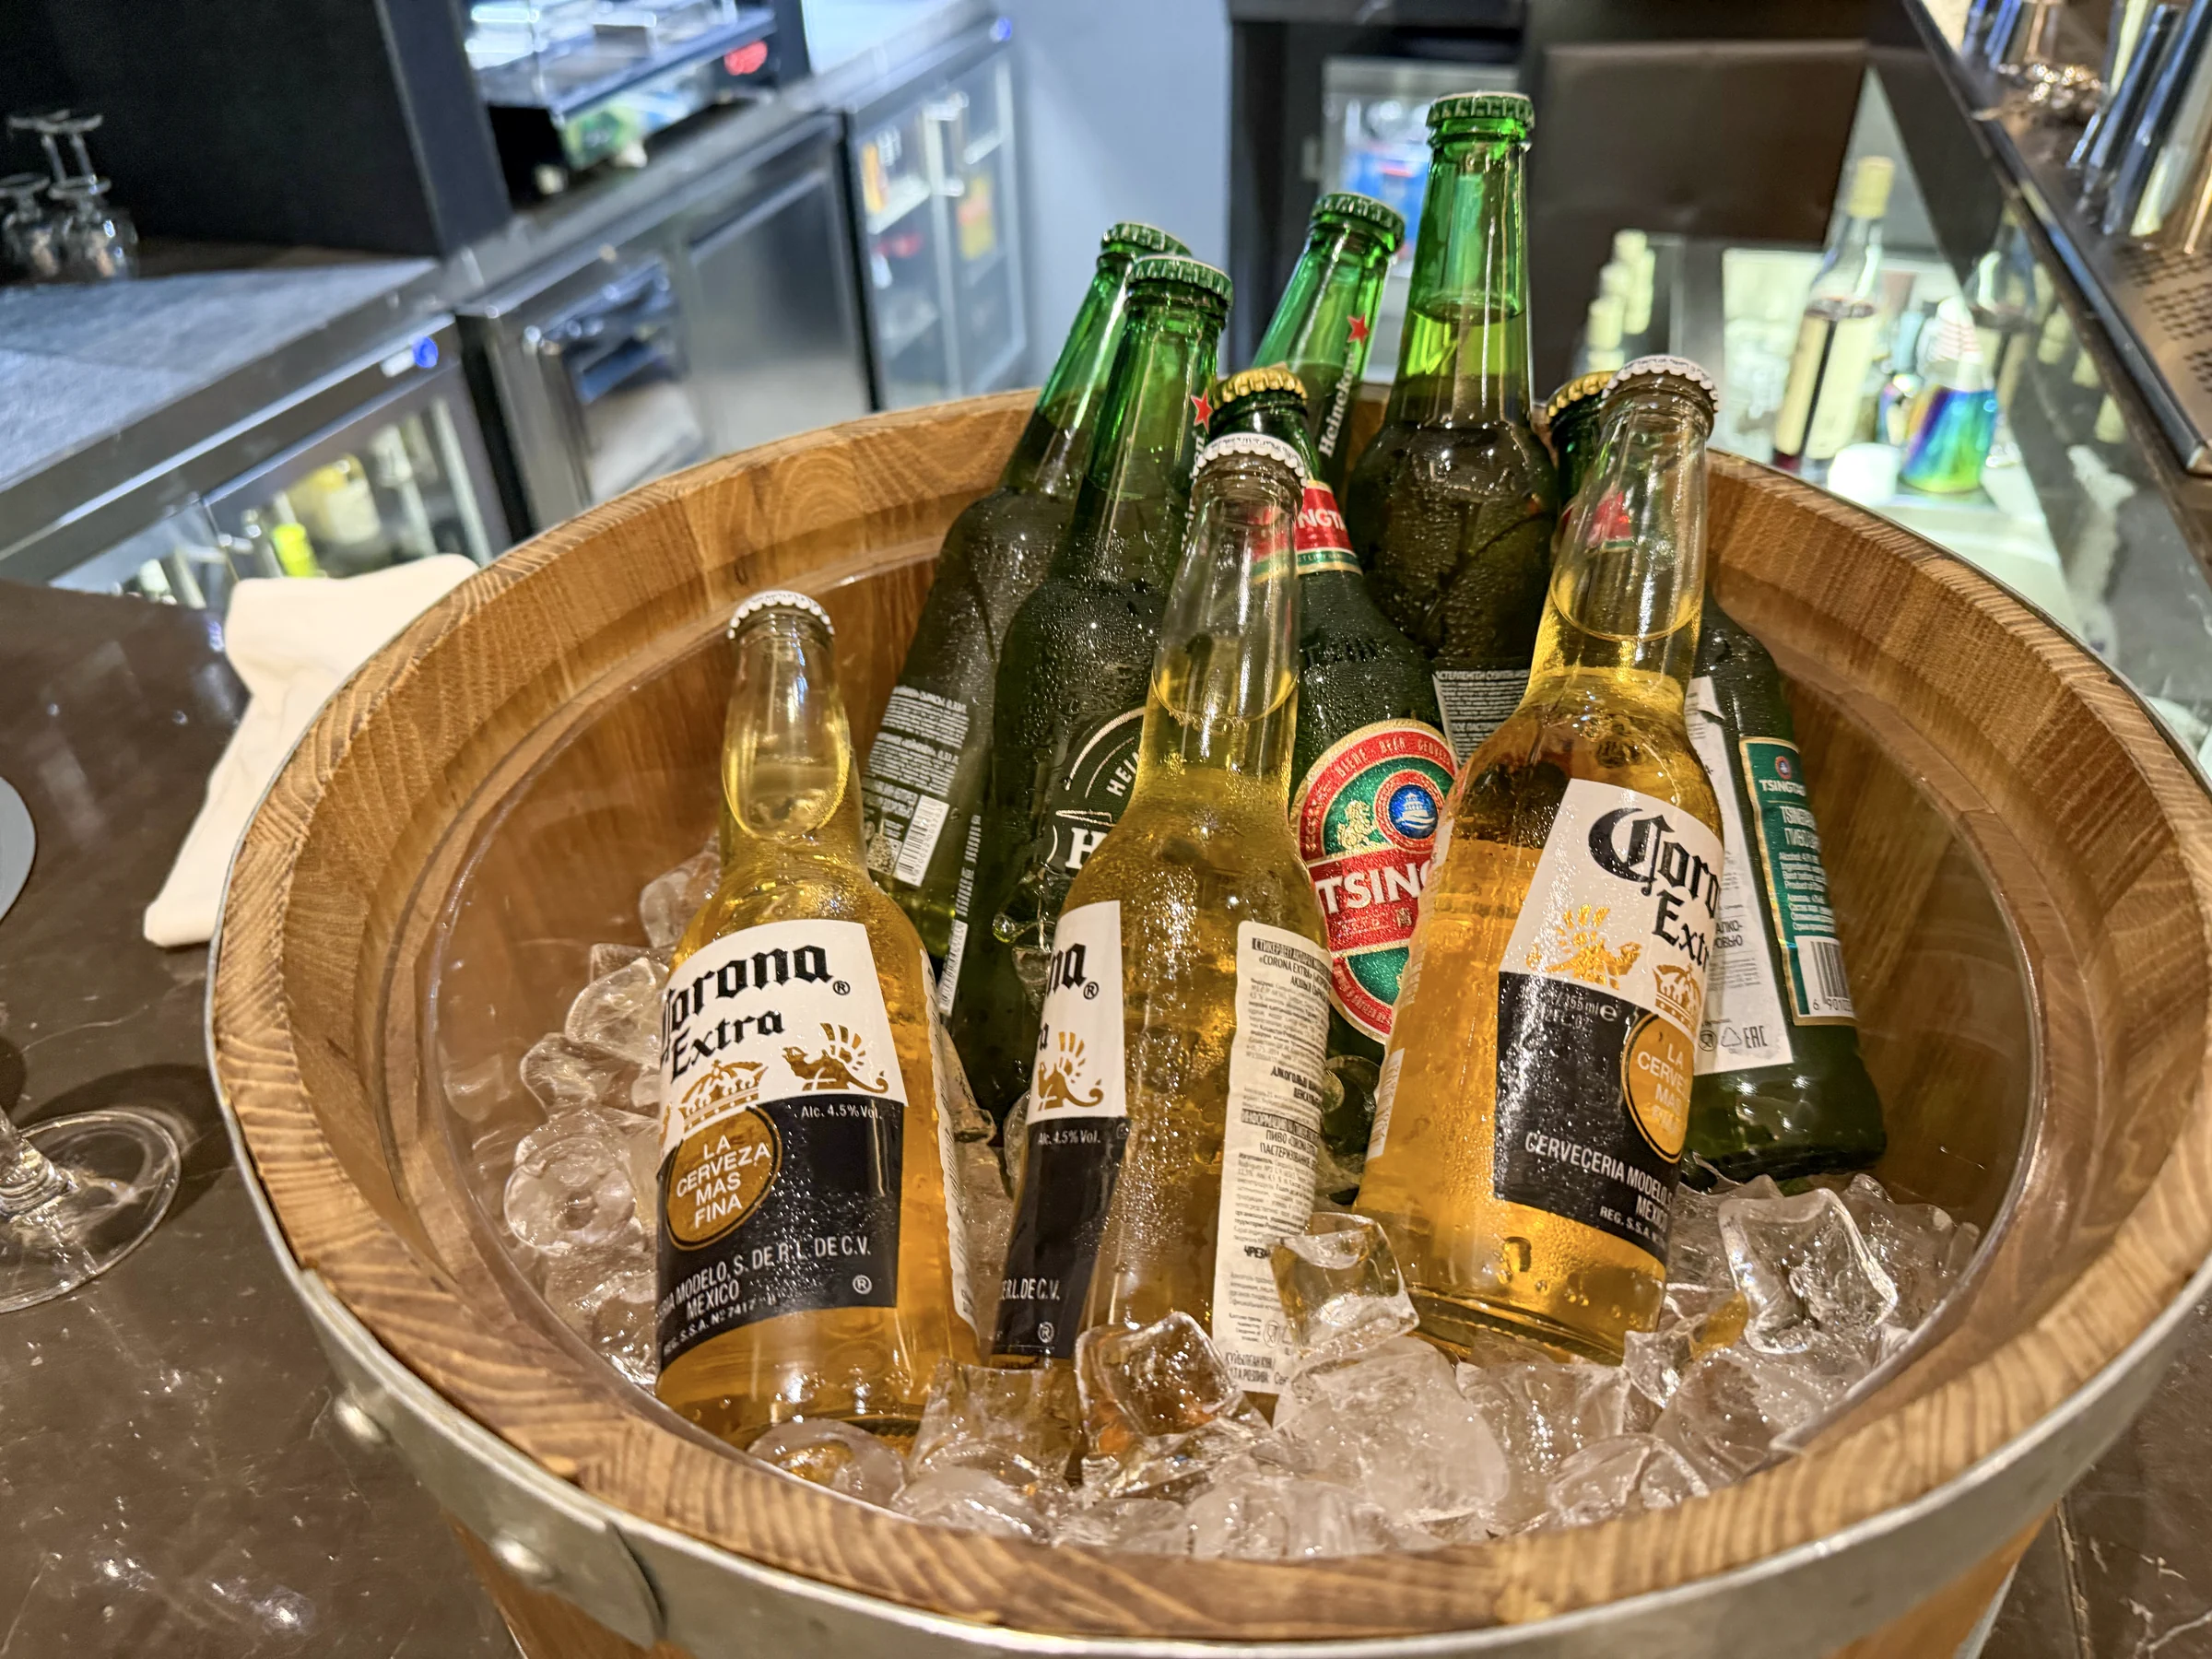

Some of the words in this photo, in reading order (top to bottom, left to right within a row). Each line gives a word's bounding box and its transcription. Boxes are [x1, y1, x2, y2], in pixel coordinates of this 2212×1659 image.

[671, 1010, 785, 1084] Extra
[704, 1135, 731, 1160] LA
[1525, 1132, 1625, 1182] CERVECERIA
[677, 1142, 771, 1197] CERVEZA
[696, 1171, 741, 1206] MAS
[694, 1194, 743, 1229] FINA
[752, 1246, 774, 1270] DE
[815, 1236, 838, 1257] DE
[841, 1234, 871, 1256] C.V.
[687, 1279, 740, 1321] MEXICO
